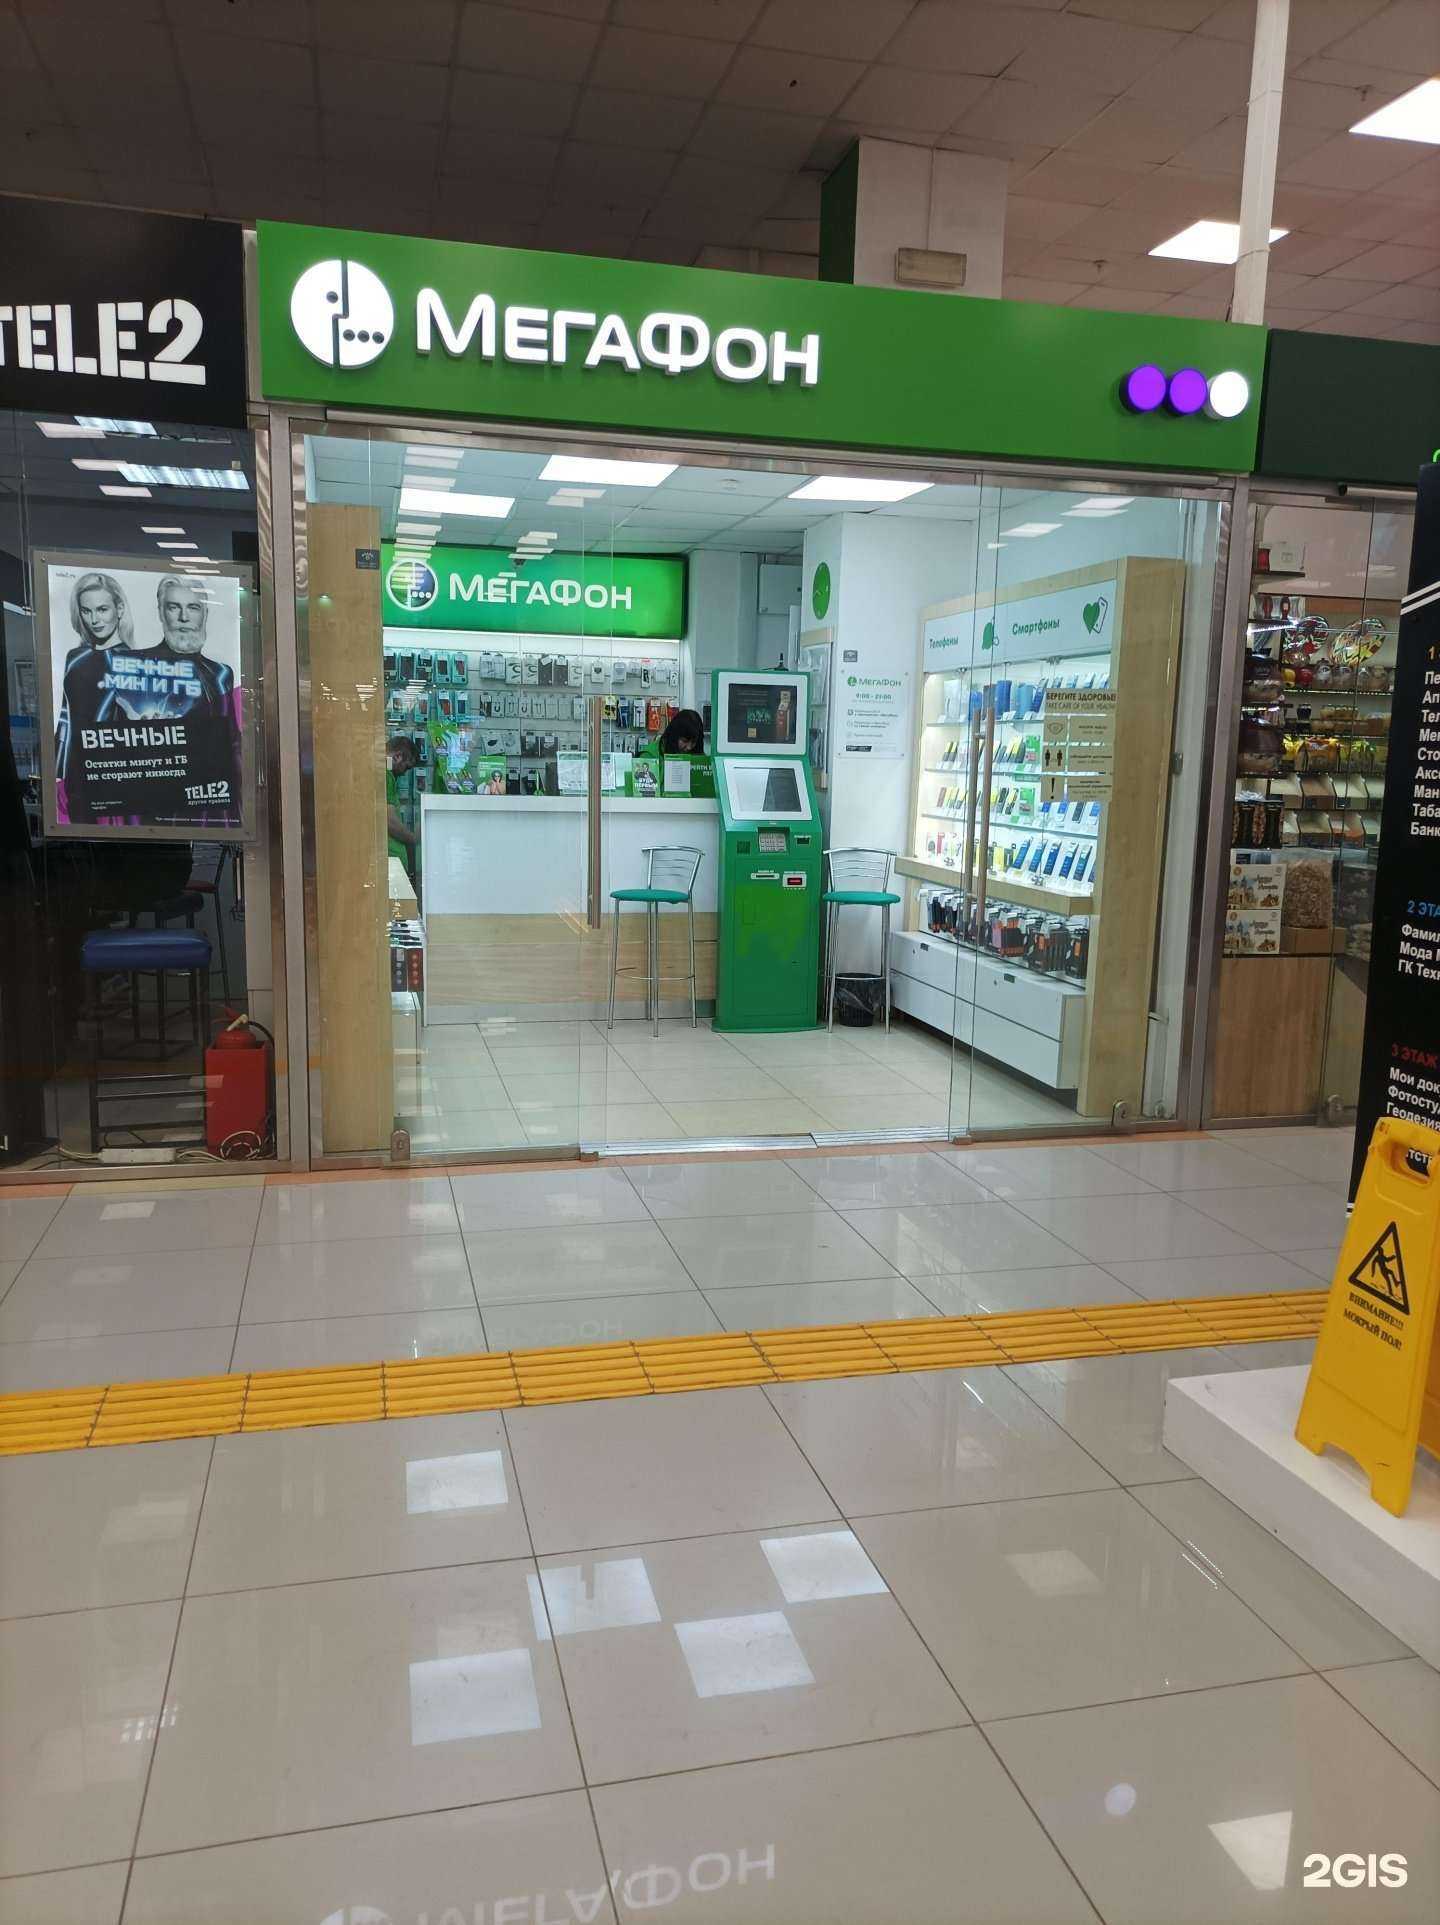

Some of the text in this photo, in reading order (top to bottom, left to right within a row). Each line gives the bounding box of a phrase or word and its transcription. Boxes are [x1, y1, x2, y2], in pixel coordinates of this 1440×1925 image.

[1012, 618, 1060, 636] Смартфоны
[112, 656, 194, 678] ВЕЧНЫЕ
[104, 673, 202, 697] МИН И ГБ
[81, 725, 187, 750] ВЕЧНЫЕ
[85, 759, 127, 769] Остатки
[129, 758, 163, 768] минут
[175, 755, 188, 764] ГБ
[87, 768, 186, 782] не сгорают никогда
[1415, 766, 1440, 780] Акс
[185, 780, 230, 800] TELE2
[1407, 900, 1416, 913] 2
[1399, 941, 1433, 960] Мода
[1397, 959, 1414, 975] ГК
[1389, 1066, 1440, 1098] Мои док
[1343, 1307, 1381, 1337] МОКРЫЙ
